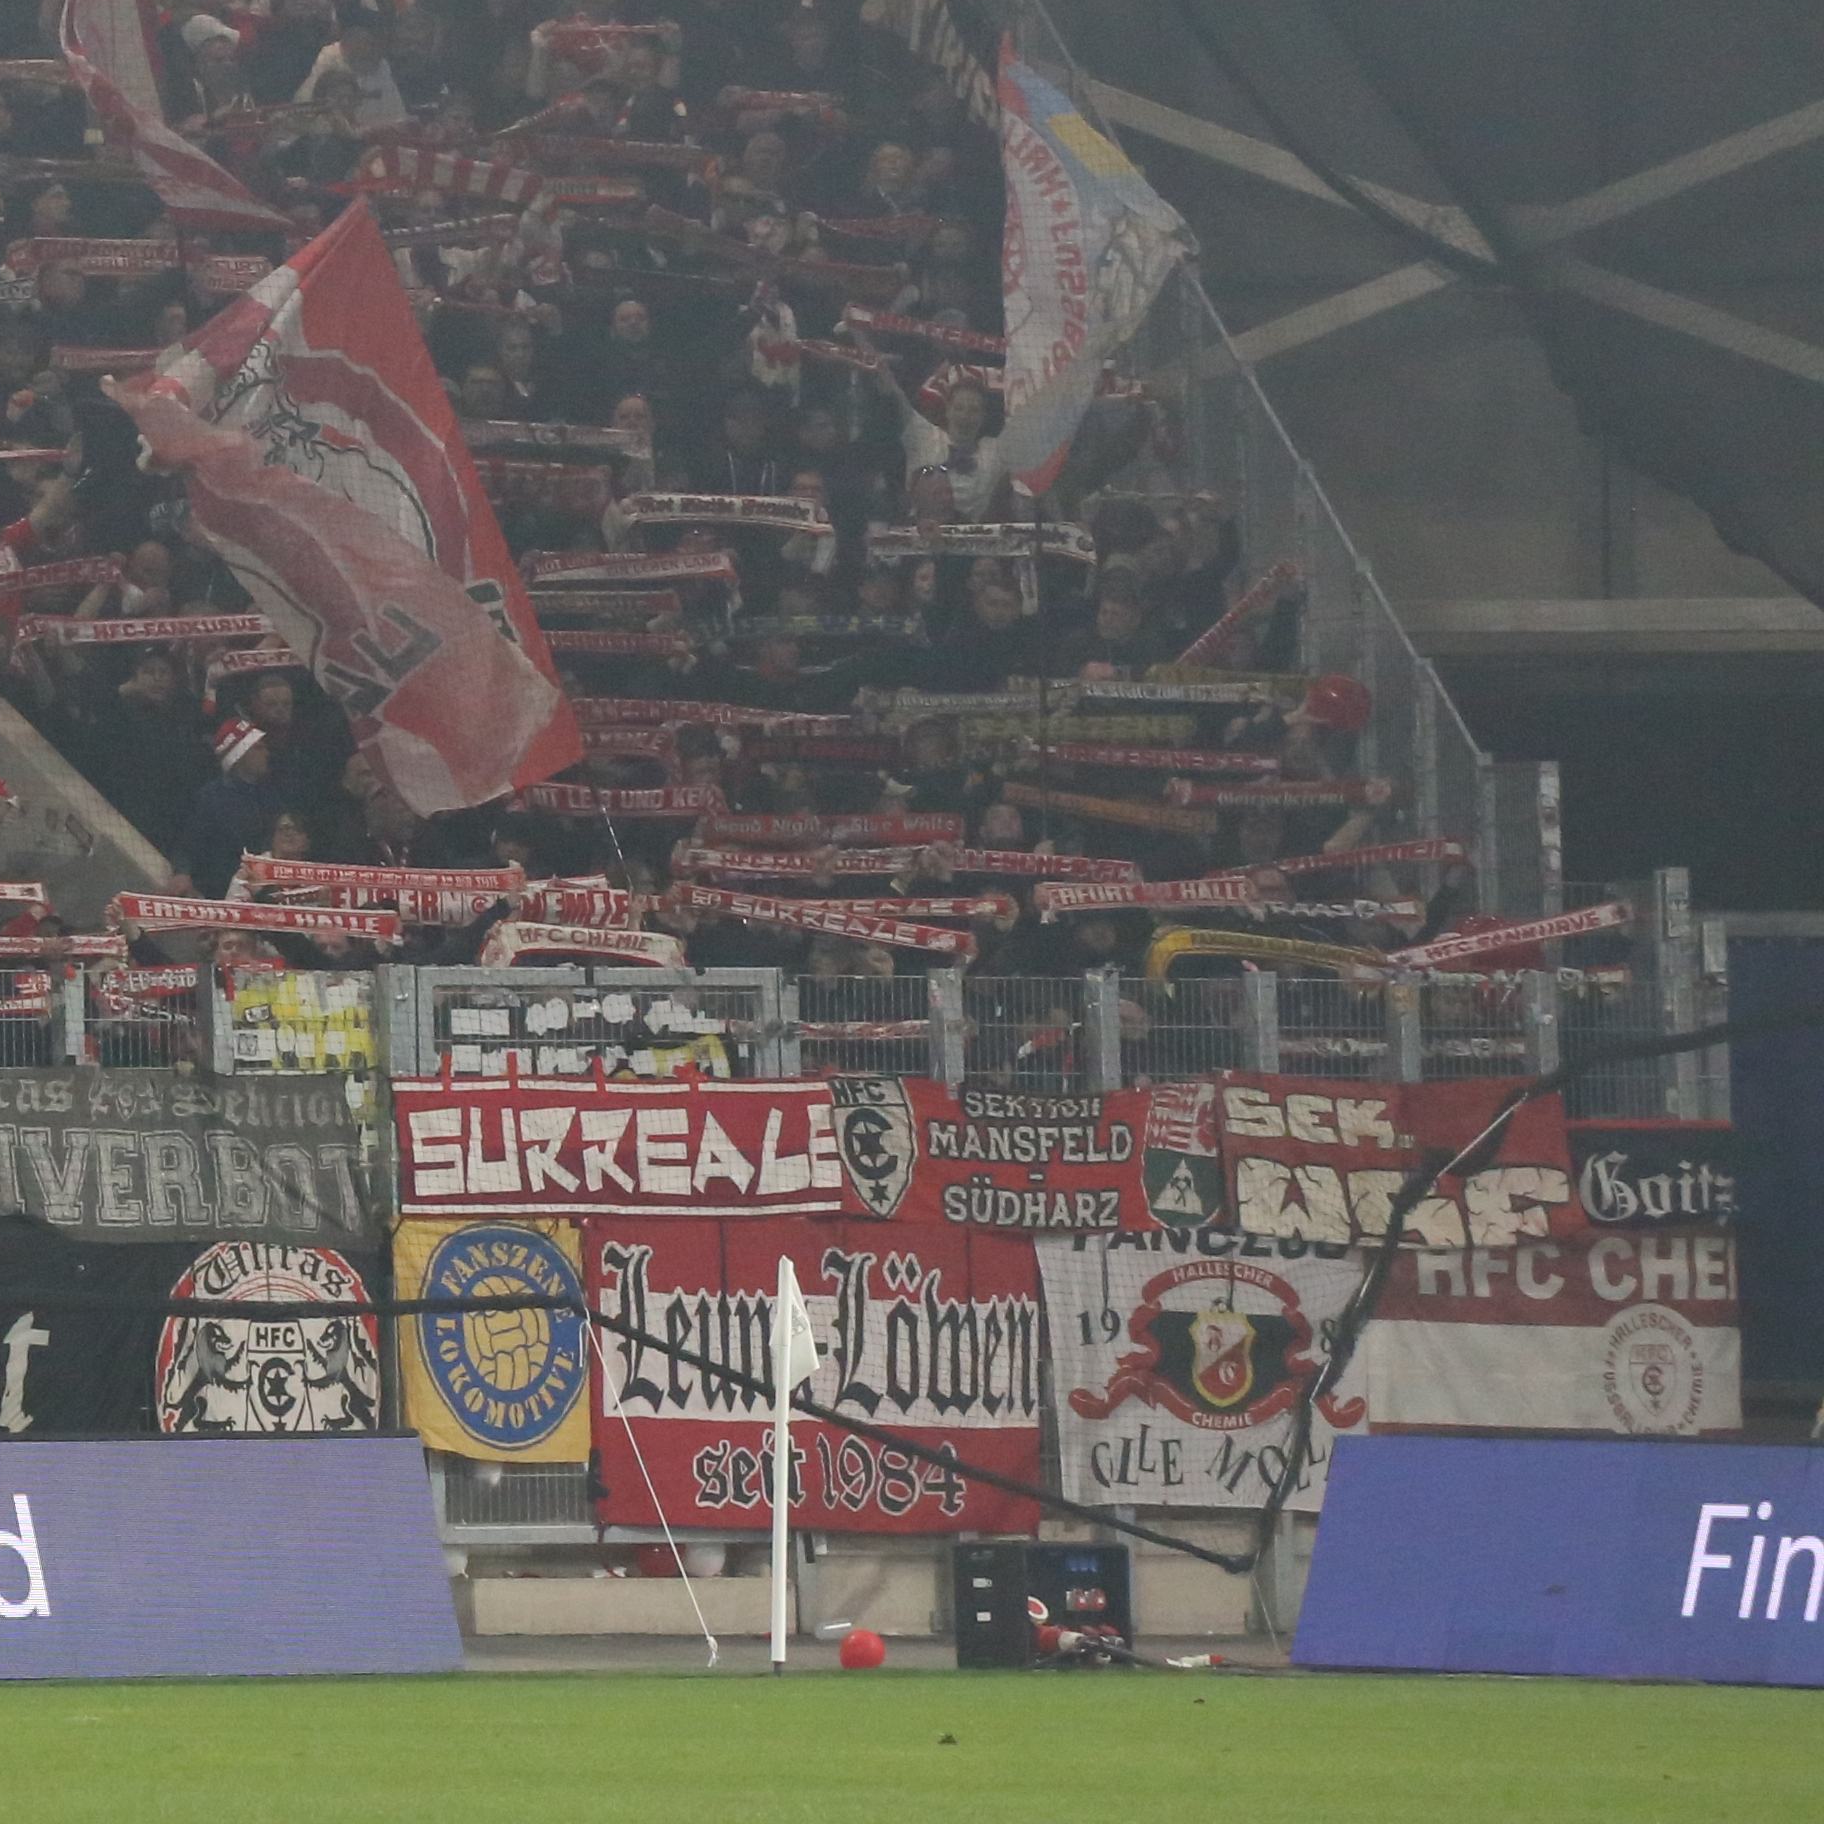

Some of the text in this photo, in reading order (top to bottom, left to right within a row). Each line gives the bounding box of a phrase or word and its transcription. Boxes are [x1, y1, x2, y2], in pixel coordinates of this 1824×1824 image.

[293, 912, 383, 934] HALLE
[518, 927, 652, 954] HFC CHEMIE
[408, 1103, 842, 1198] SURREALE
[929, 1120, 1133, 1164] MANSFELD
[943, 1177, 1121, 1227] SÜDHARZ
[1172, 1264, 1276, 1288] HALLESCHER
[1416, 1237, 1736, 1302] HFC CHE
[255, 1327, 297, 1350] HFC
[601, 1242, 1040, 1418] Leun-Löwen
[1191, 1410, 1254, 1429] CHEMIE
[818, 1432, 966, 1516] 1984
